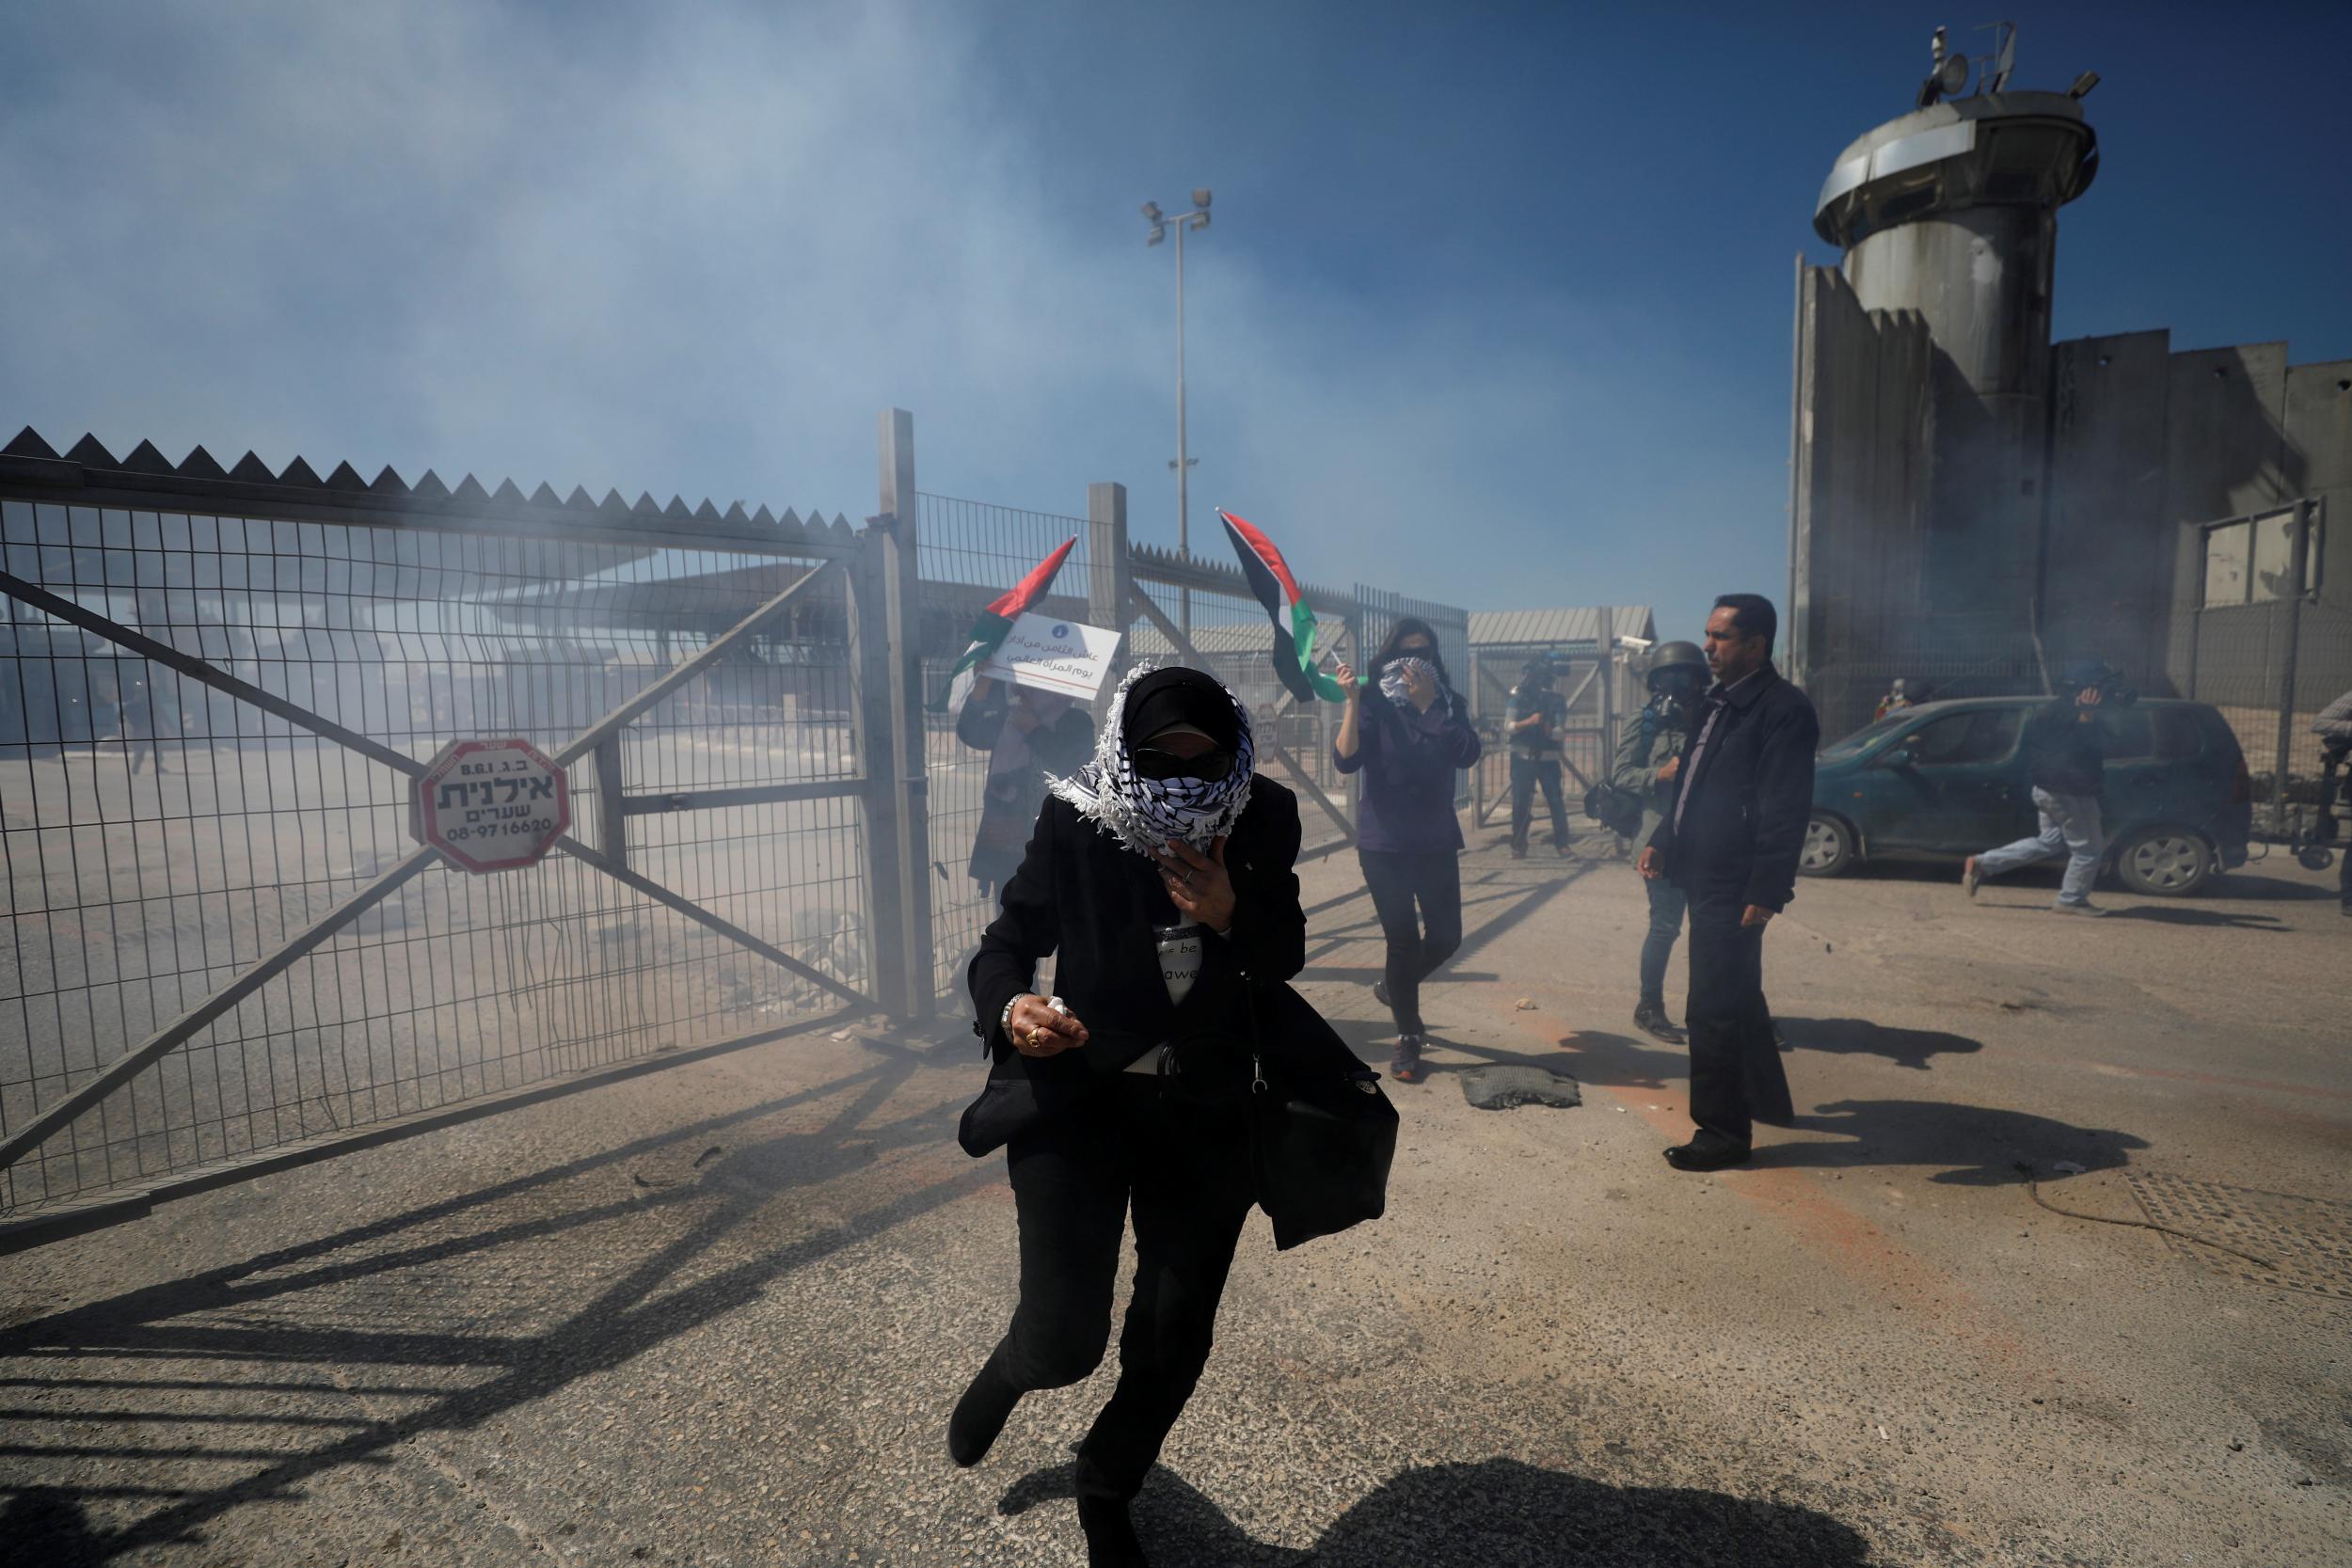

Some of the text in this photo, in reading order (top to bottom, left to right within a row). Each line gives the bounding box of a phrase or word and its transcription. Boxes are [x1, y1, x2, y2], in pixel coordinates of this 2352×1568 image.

[1024, 641, 1041, 649] من
[1072, 668, 1093, 680] يوم
[482, 741, 506, 750] שער
[437, 774, 554, 809] אילנית
[466, 804, 531, 823] שערים
[447, 817, 551, 841] 08-9716620
[1180, 942, 1197, 954] be
